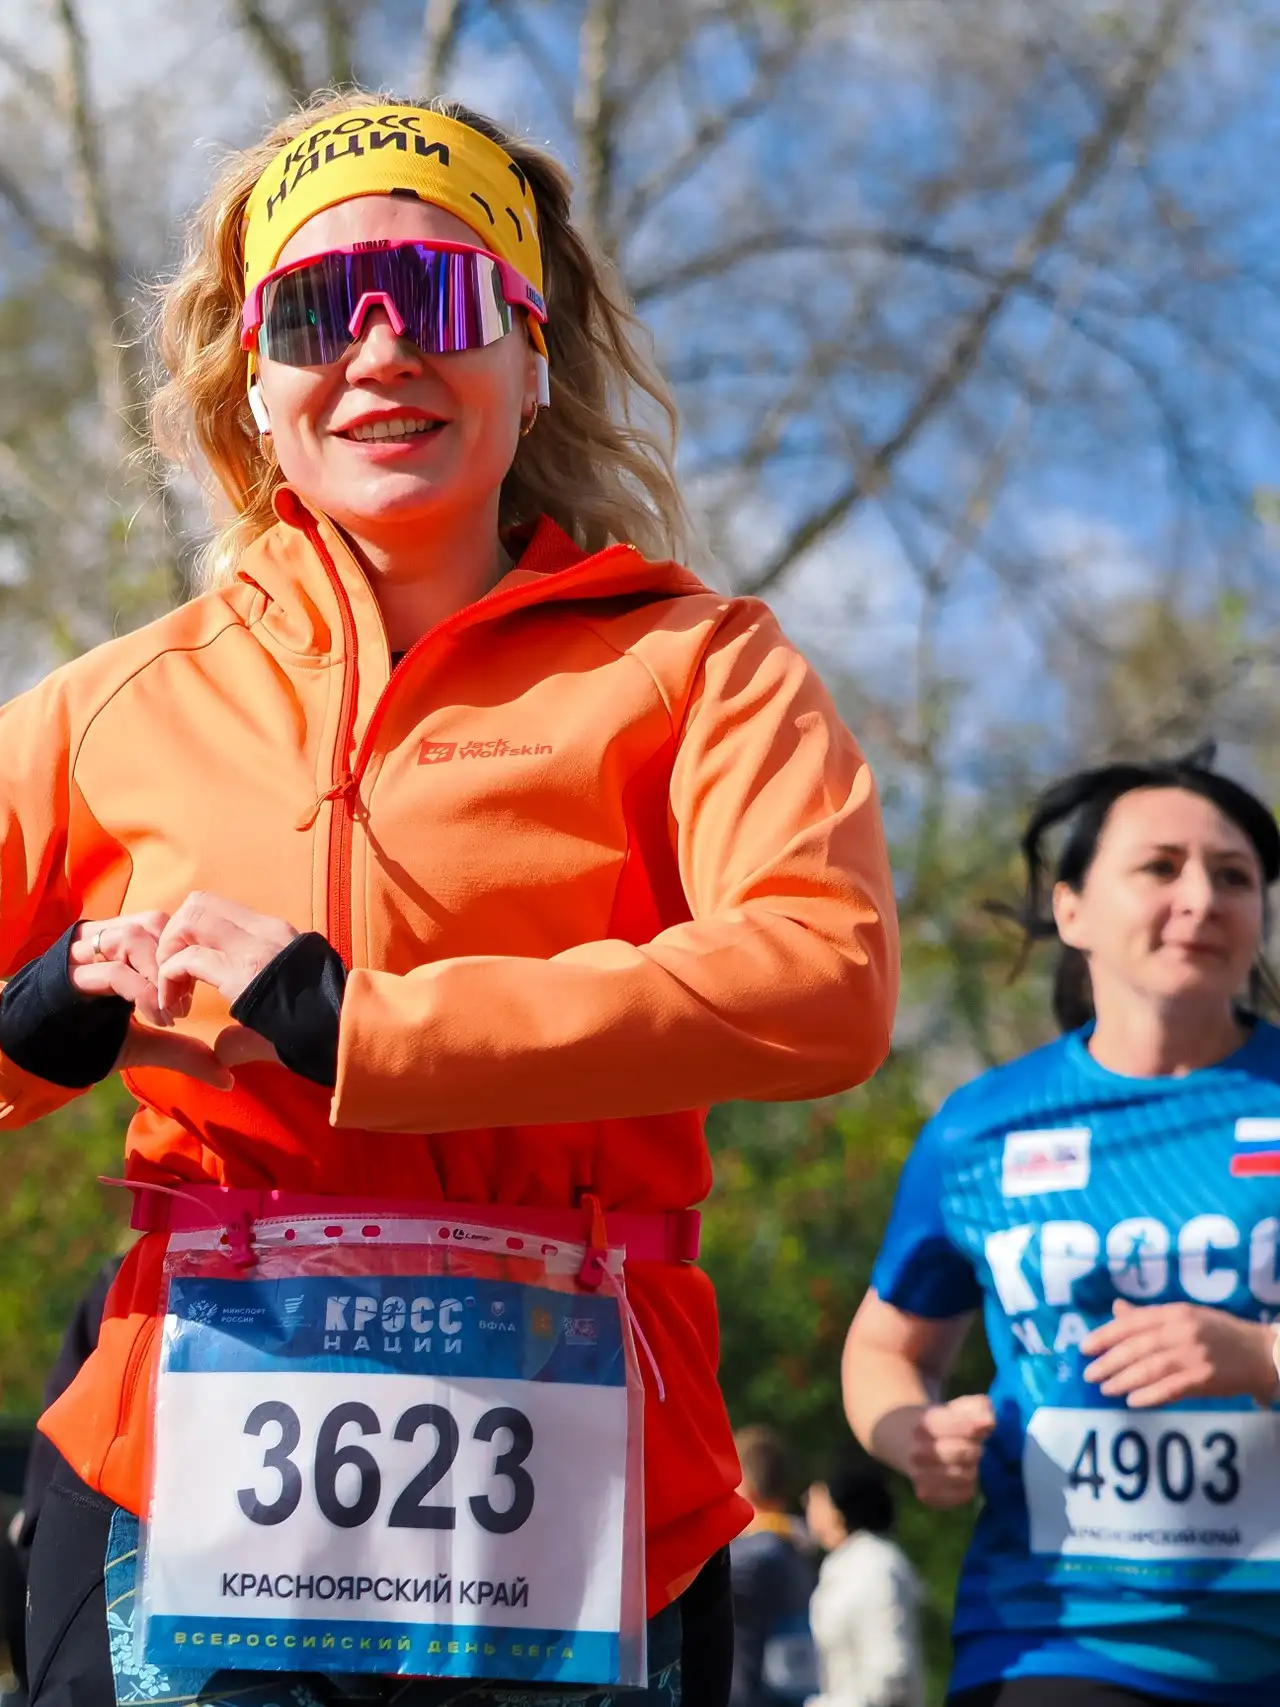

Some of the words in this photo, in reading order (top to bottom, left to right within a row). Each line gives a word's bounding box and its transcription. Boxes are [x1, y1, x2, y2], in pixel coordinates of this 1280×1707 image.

[283, 114, 421, 177] КРОСС
[266, 131, 450, 222] НАЦИИ
[458, 743, 553, 760] Wolfskin
[459, 738, 510, 750] Jack
[324, 1296, 463, 1335] КРОСС
[478, 1320, 516, 1332] ВФЛА
[323, 1335, 462, 1354] НАЦИИ
[237, 1400, 535, 1535] 3623
[1070, 1429, 1240, 1504] 4903
[222, 1573, 452, 1604] КРАСНОЯРСКИЙ
[459, 1576, 530, 1608] КРАЙ
[174, 1631, 411, 1651] ВСЕРОССИЙСКИЙ
[427, 1640, 496, 1655] ДЕНЬ
[511, 1643, 574, 1659] БЕГА
